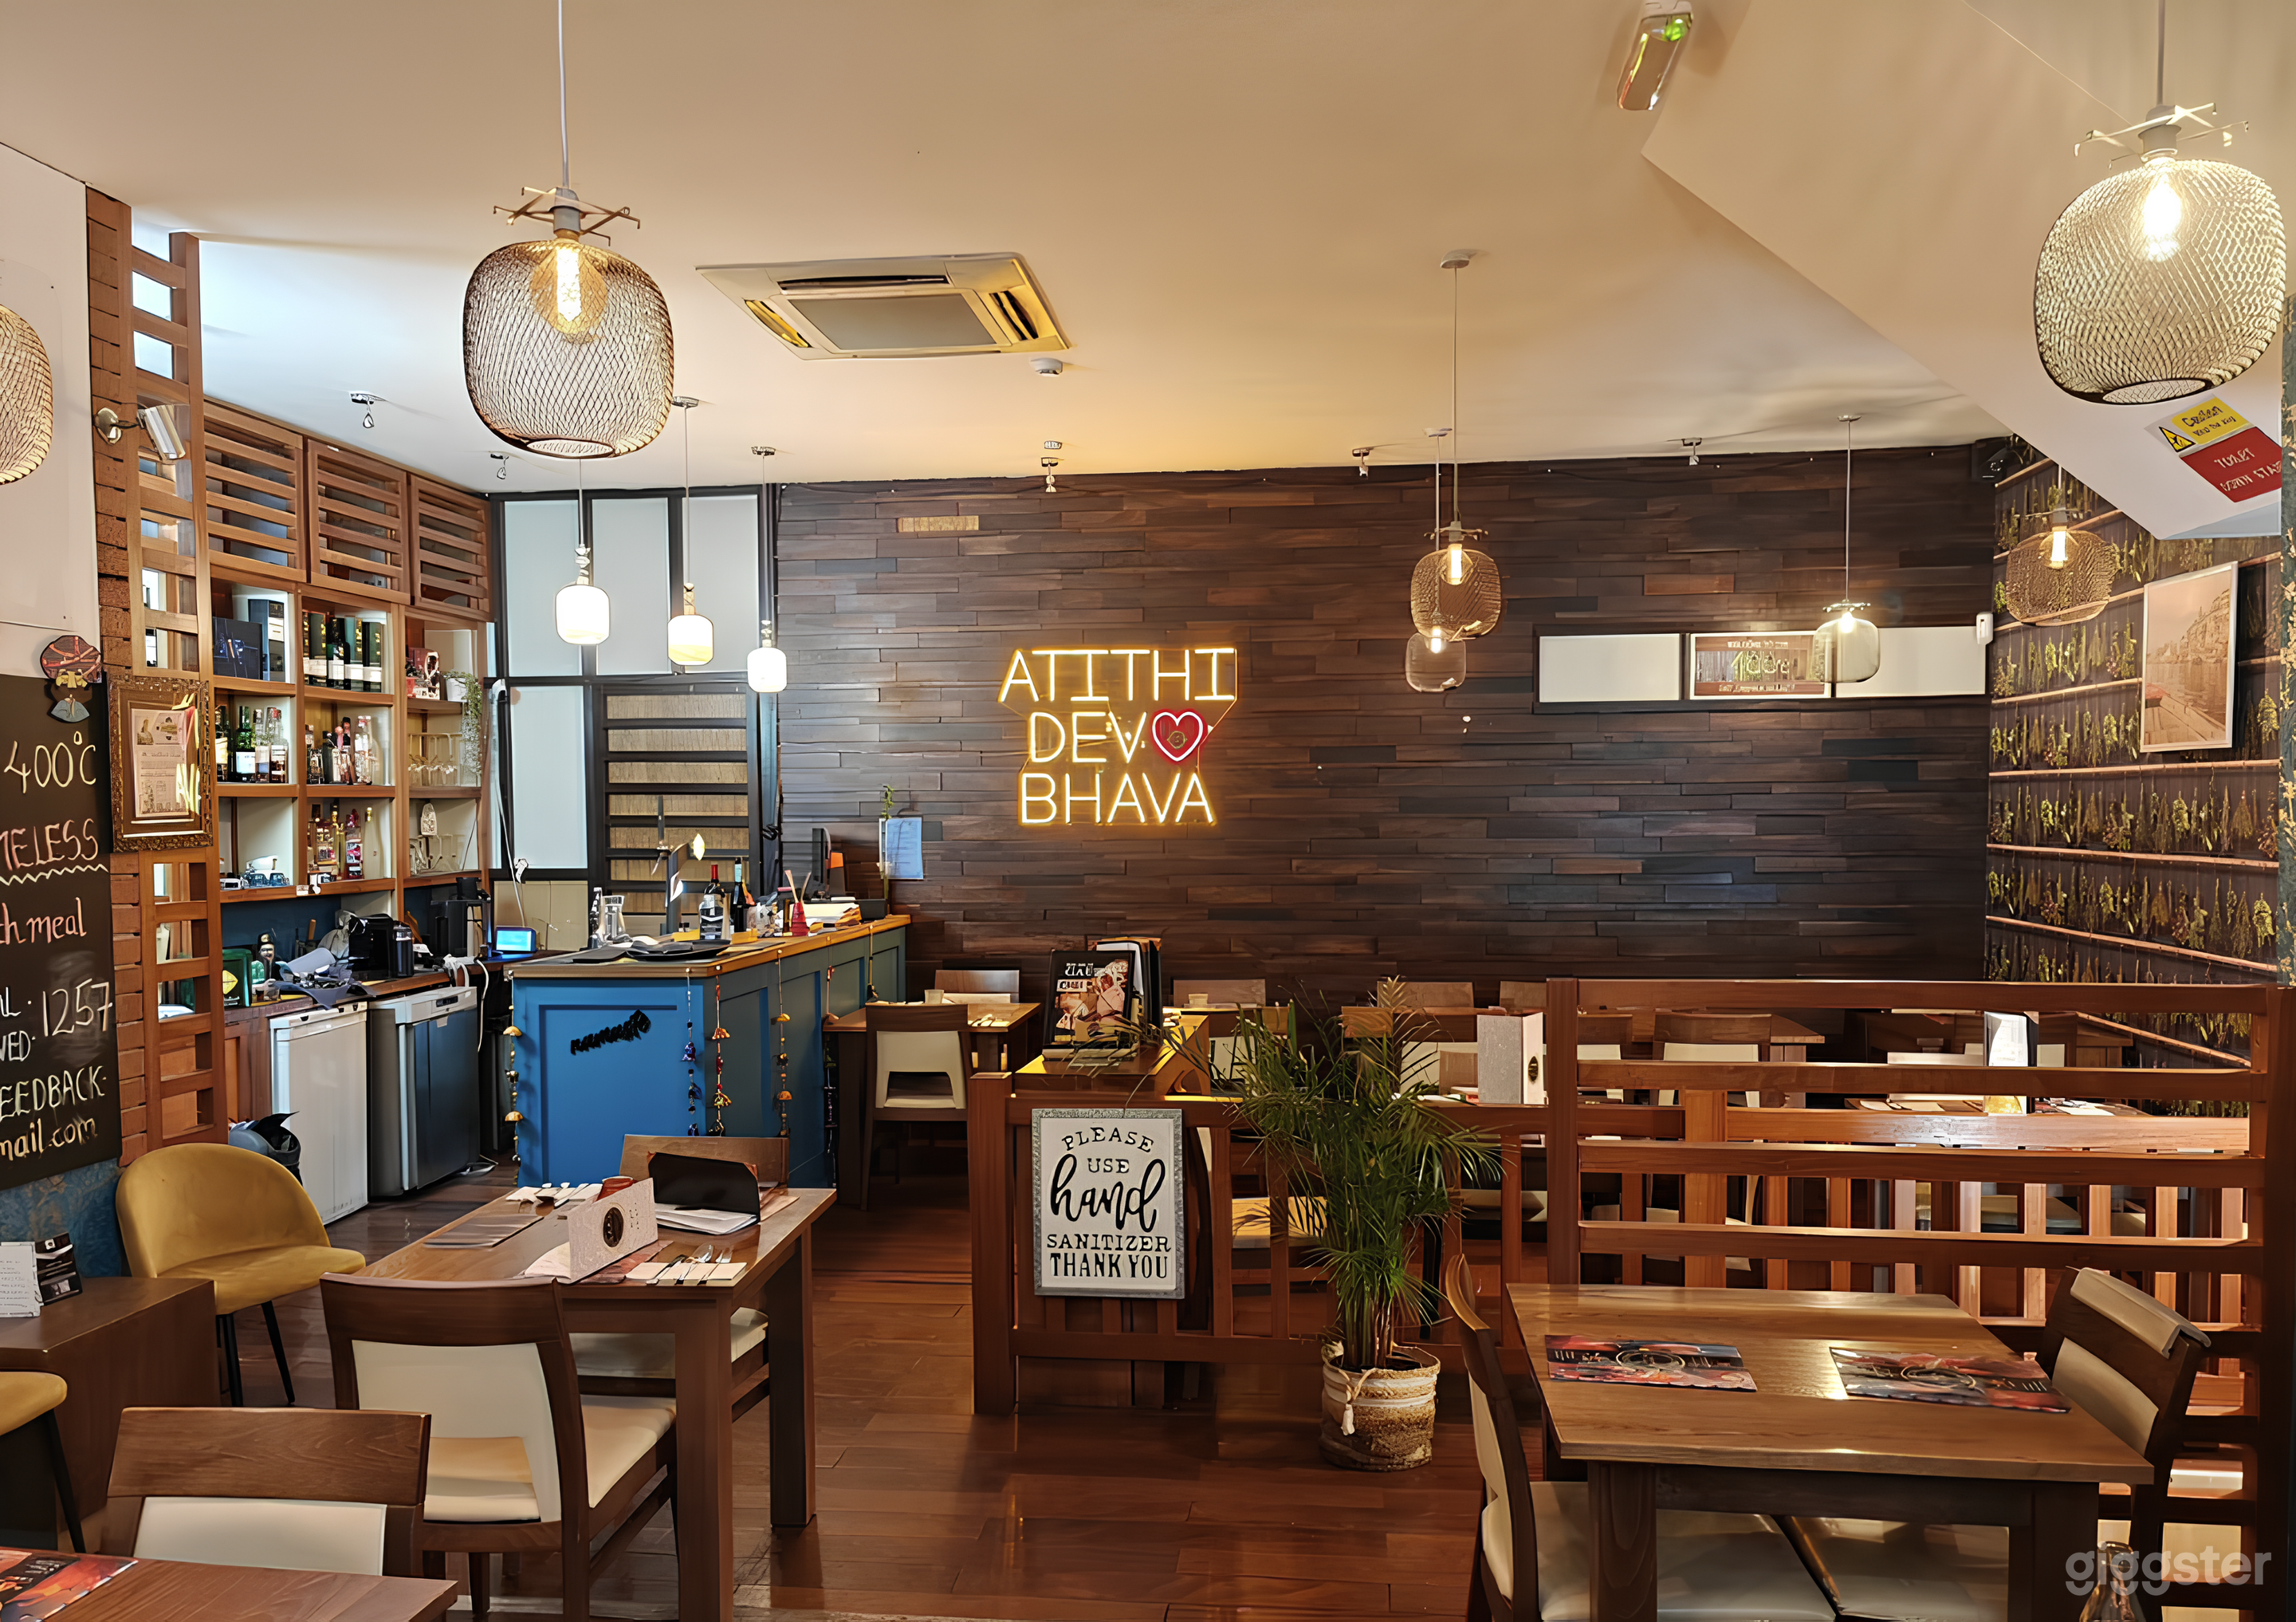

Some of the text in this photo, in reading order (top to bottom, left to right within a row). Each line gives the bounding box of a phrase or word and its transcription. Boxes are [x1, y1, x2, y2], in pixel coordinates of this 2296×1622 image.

[998, 648, 1236, 703] ATITHI
[1020, 772, 1215, 825] BHAVA
[26, 896, 87, 943] meal
[42, 978, 113, 1037] 1257
[1061, 1127, 1154, 1153] PLEASE
[1087, 1158, 1130, 1174] USE
[1050, 1153, 1166, 1233] hand
[1047, 1234, 1172, 1252] SANITIZER
[1050, 1253, 1168, 1278] THANK YOU
